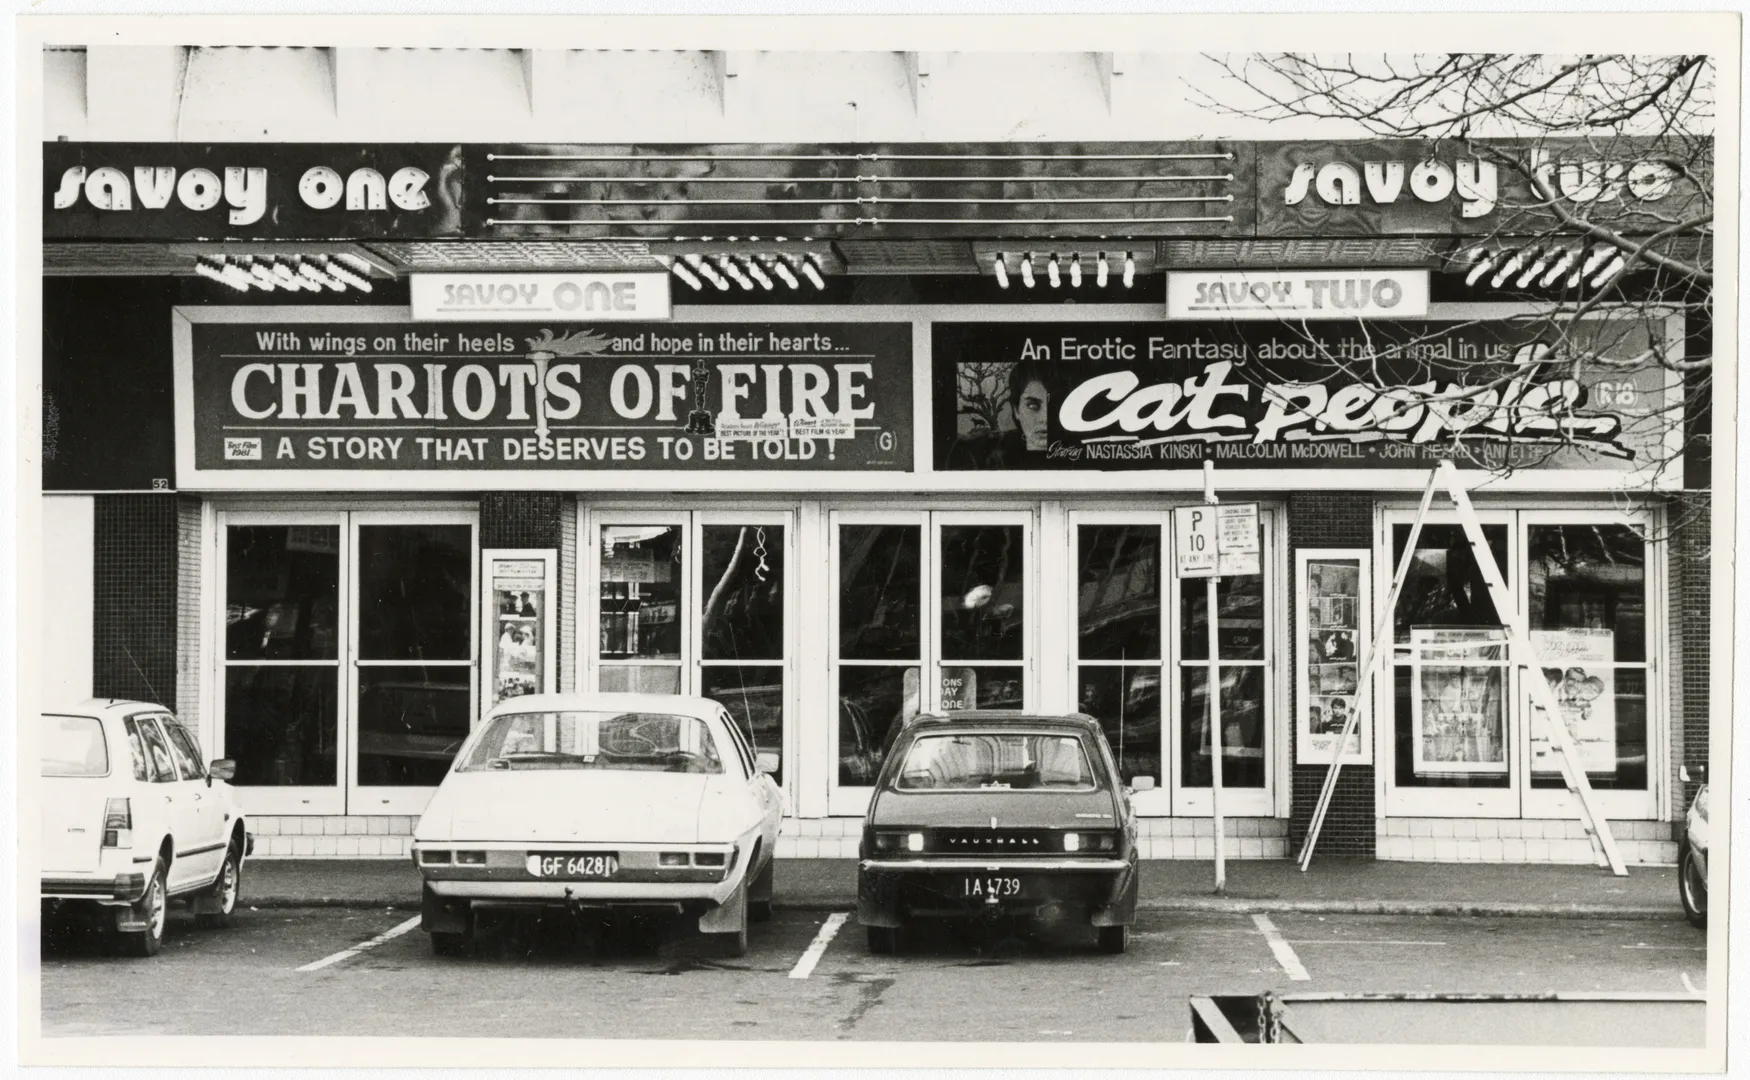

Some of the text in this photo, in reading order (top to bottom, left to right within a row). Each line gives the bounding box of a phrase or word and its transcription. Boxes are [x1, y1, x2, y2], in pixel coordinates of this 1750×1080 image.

[443, 281, 637, 312] SAVOY ONE
[1194, 278, 1403, 310] SAVOY TWO
[256, 331, 301, 351] With
[308, 333, 367, 356] wings
[373, 338, 396, 351] on
[403, 332, 449, 352] their
[458, 333, 515, 352] heels
[611, 333, 645, 351] and
[650, 333, 693, 356] hope
[698, 333, 713, 351] in
[718, 333, 763, 351] their
[1020, 338, 1050, 360] An
[1060, 337, 1136, 361] Erotic
[1148, 337, 1248, 366] Fantasy
[1258, 337, 1324, 360] about
[1336, 338, 1377, 360] the
[1385, 337, 1452, 359] animal
[1458, 337, 1478, 359] in
[230, 362, 876, 421] CHARIOTS OF FIRE
[276, 437, 296, 460] A
[307, 437, 404, 461] STORY
[415, 437, 488, 461] THAT
[502, 437, 646, 461] DESERVES
[653, 438, 693, 461] TO
[703, 438, 736, 460] BE
[1086, 443, 1153, 459] NASTASSIA
[1160, 443, 1203, 459] KINSKI
[1216, 443, 1287, 459] MALCOLM
[1291, 443, 1365, 459] McDOWELL
[1379, 443, 1416, 459] JOHN
[1422, 443, 1471, 459] HEARD
[153, 480, 167, 489] 52
[1192, 510, 1203, 532] P
[1189, 534, 1205, 552] 10
[541, 856, 565, 876] GF
[965, 878, 983, 896] IA
